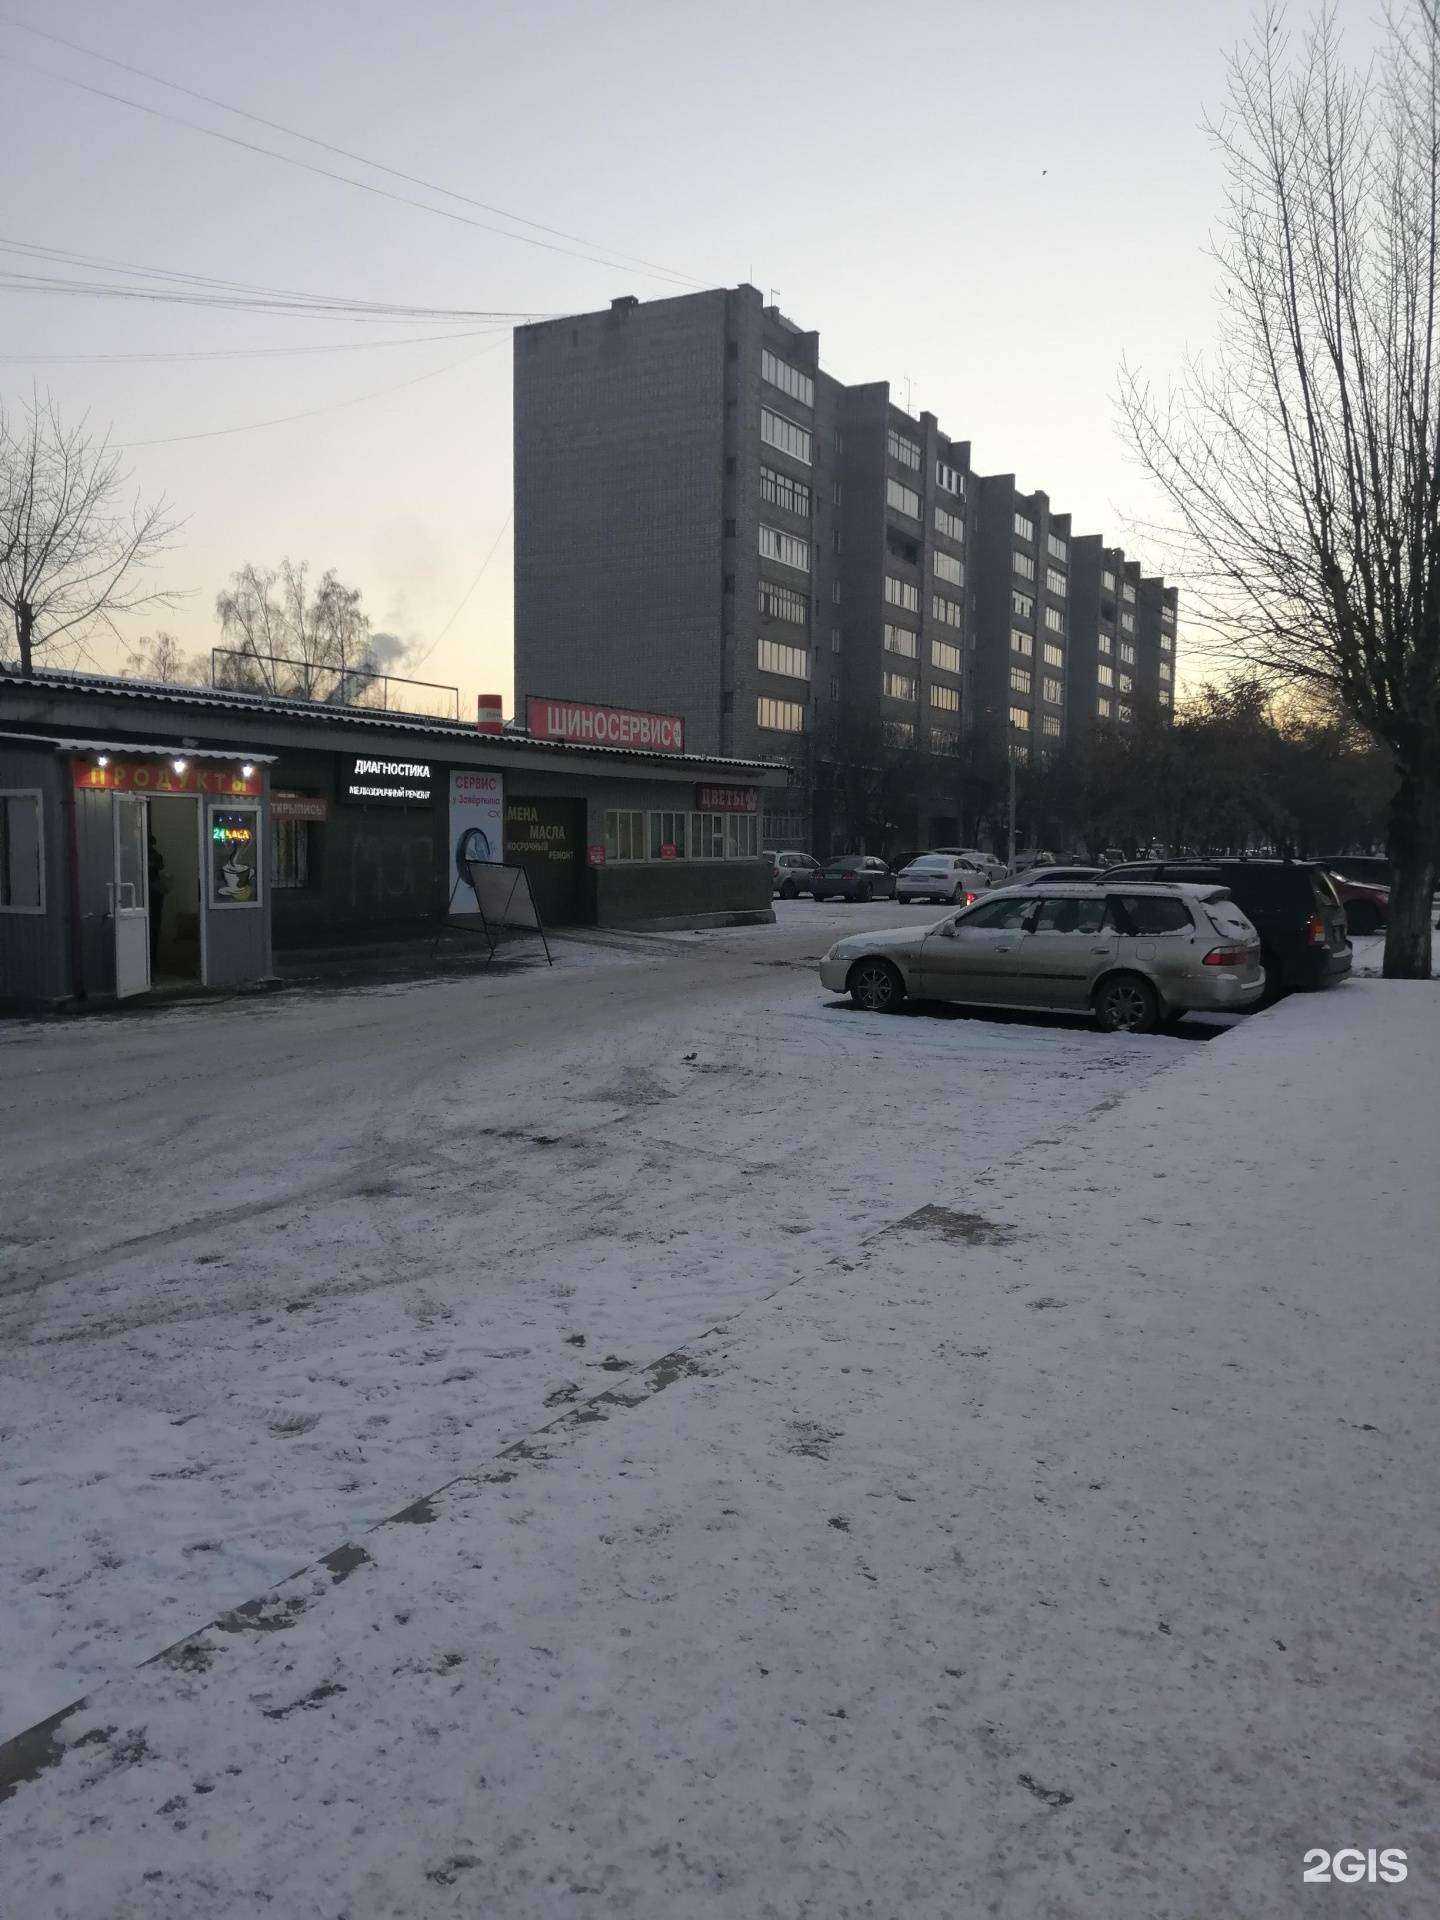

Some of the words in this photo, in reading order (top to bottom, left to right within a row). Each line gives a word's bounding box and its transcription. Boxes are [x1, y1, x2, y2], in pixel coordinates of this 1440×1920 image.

[546, 706, 672, 746] ШИНОСЕРВИС
[354, 759, 431, 778] ДИАГНОСТИКА
[89, 766, 247, 793] ПРОДУКТЫ
[455, 775, 497, 791] СЕРВИС
[702, 787, 744, 808] ЦВЕТЫ
[507, 806, 538, 822] МЕНА
[529, 825, 566, 840] МАСЛА
